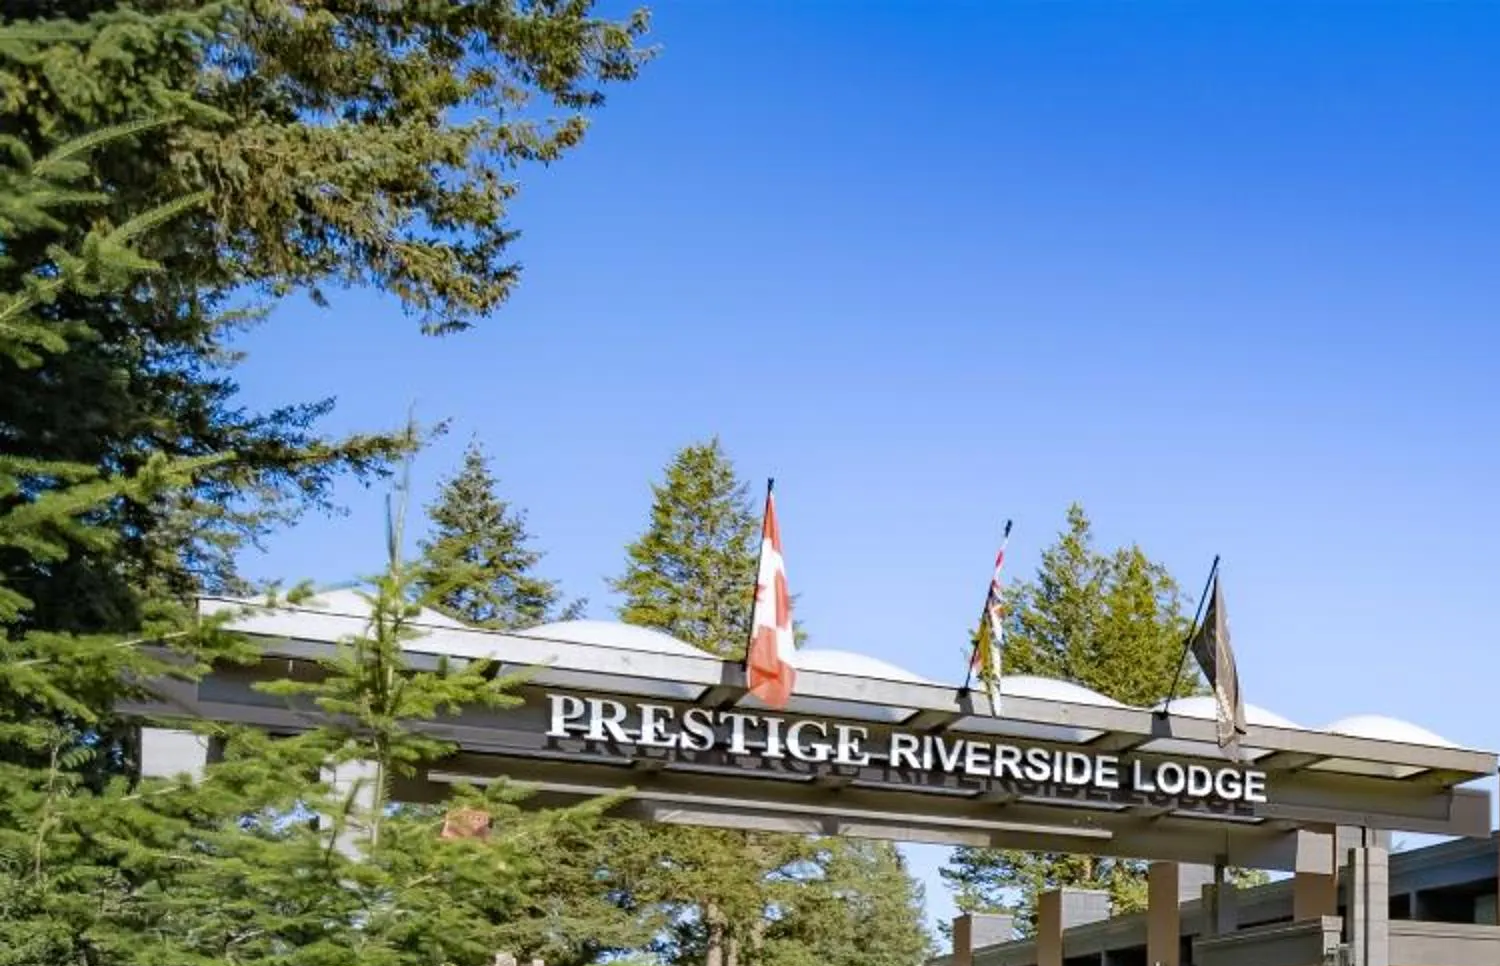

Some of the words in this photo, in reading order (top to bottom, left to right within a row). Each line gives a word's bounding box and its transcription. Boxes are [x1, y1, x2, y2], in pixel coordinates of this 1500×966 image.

[545, 692, 870, 768] PRESTIGE
[888, 733, 1119, 790] RIVERSIDE
[1132, 759, 1268, 804] LODGE
